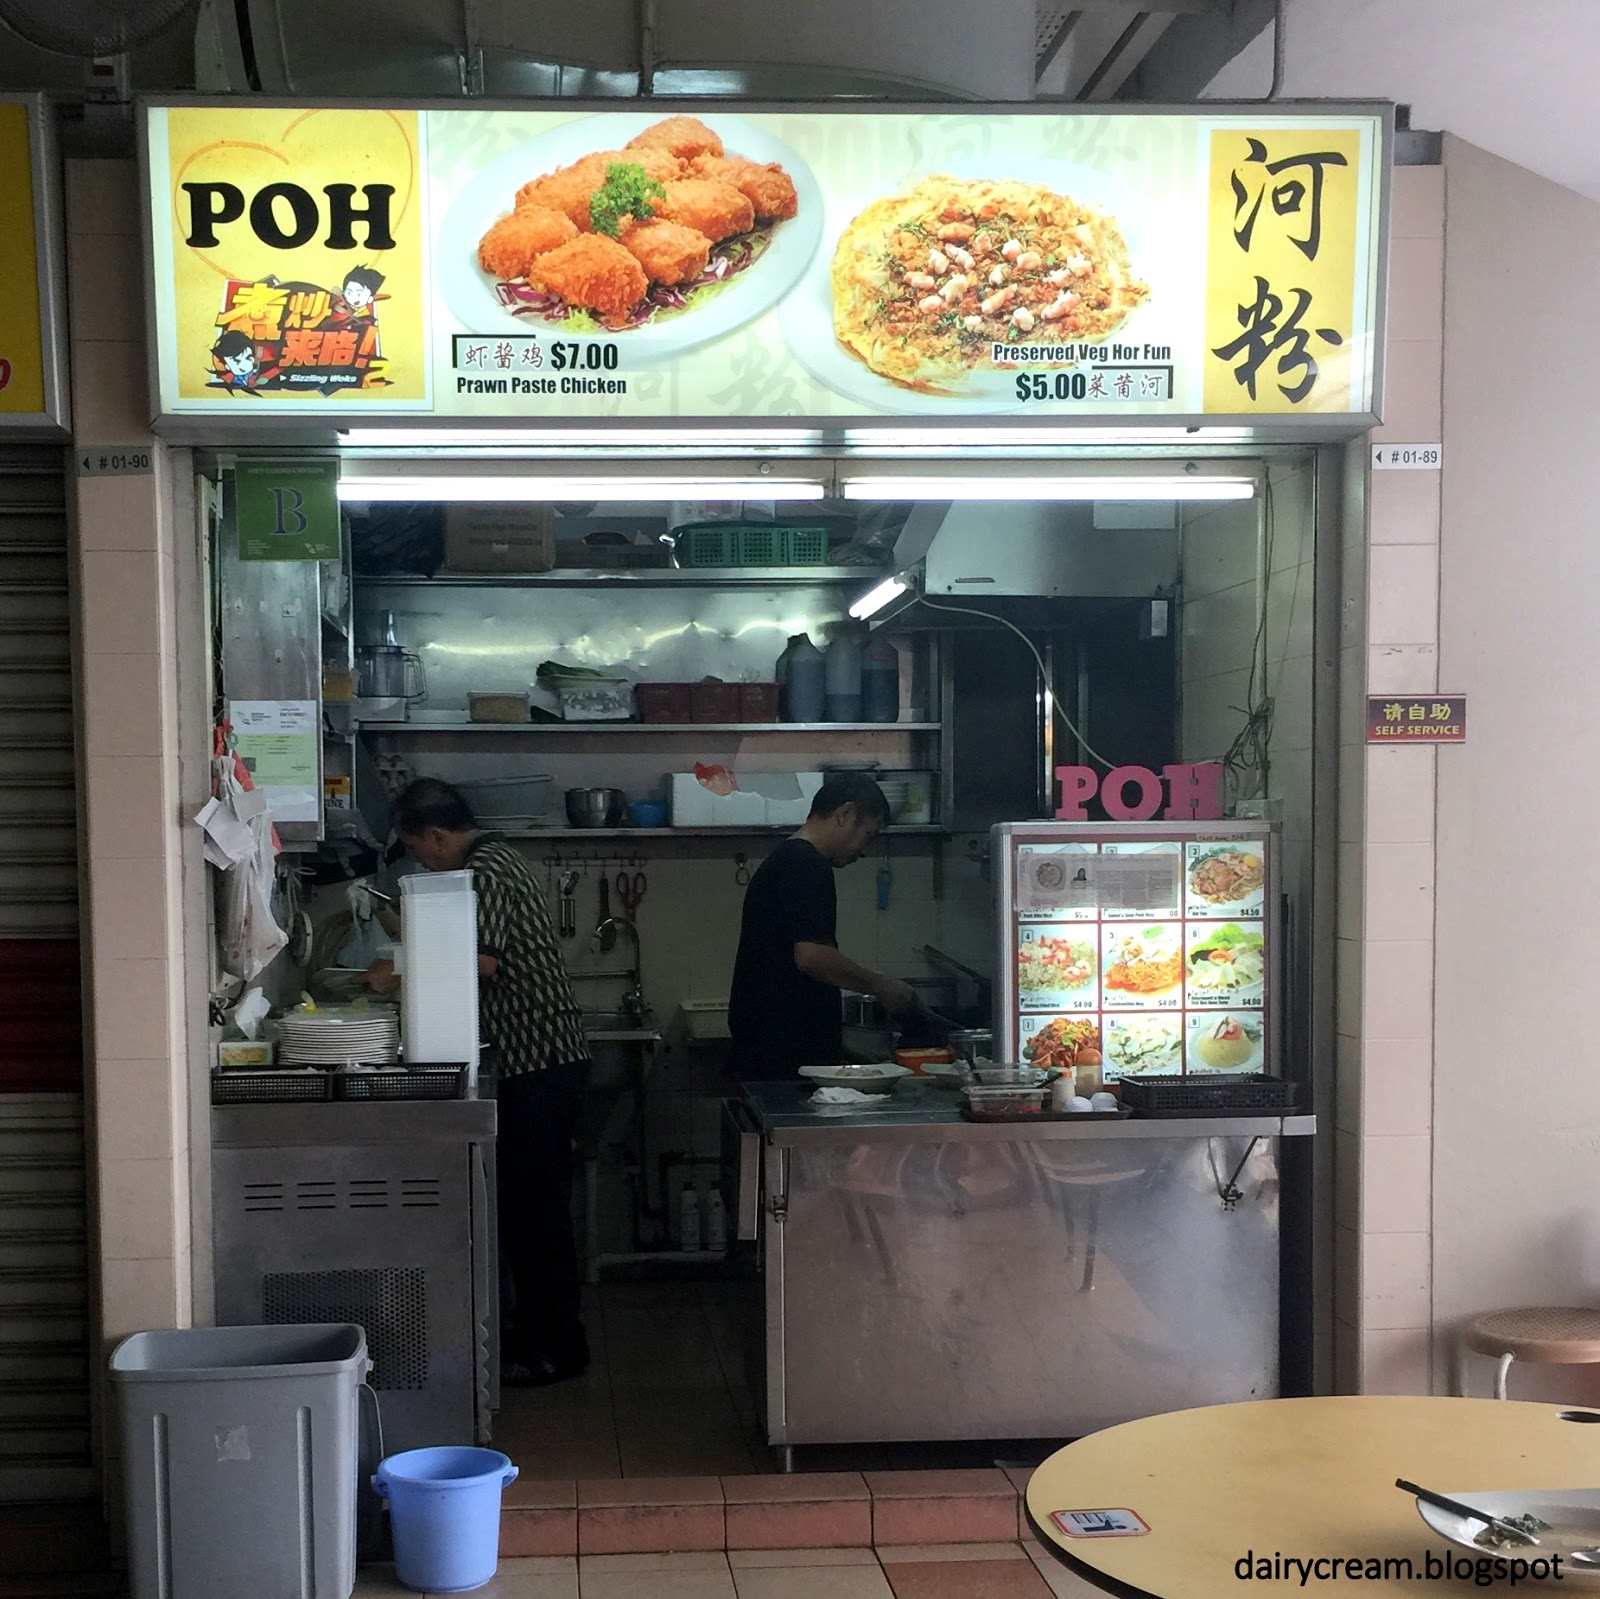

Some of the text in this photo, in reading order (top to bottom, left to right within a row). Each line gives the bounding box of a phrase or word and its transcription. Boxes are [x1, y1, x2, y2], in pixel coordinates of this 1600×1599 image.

[180, 181, 397, 250] POH
[1211, 136, 1348, 404] 河粉
[465, 341, 618, 371] 虾酱鸡 $7.00
[993, 344, 1171, 362] Preserved Veg Hor Fun
[289, 374, 357, 384] Sizzling Woks
[457, 377, 627, 394] Prawn Paste Chicken
[1015, 372, 1086, 402] $5.00
[267, 487, 308, 536] B
[1383, 703, 1451, 721] 请自助
[1375, 725, 1460, 735] SELF SERVICE
[1055, 763, 1225, 821] POH
